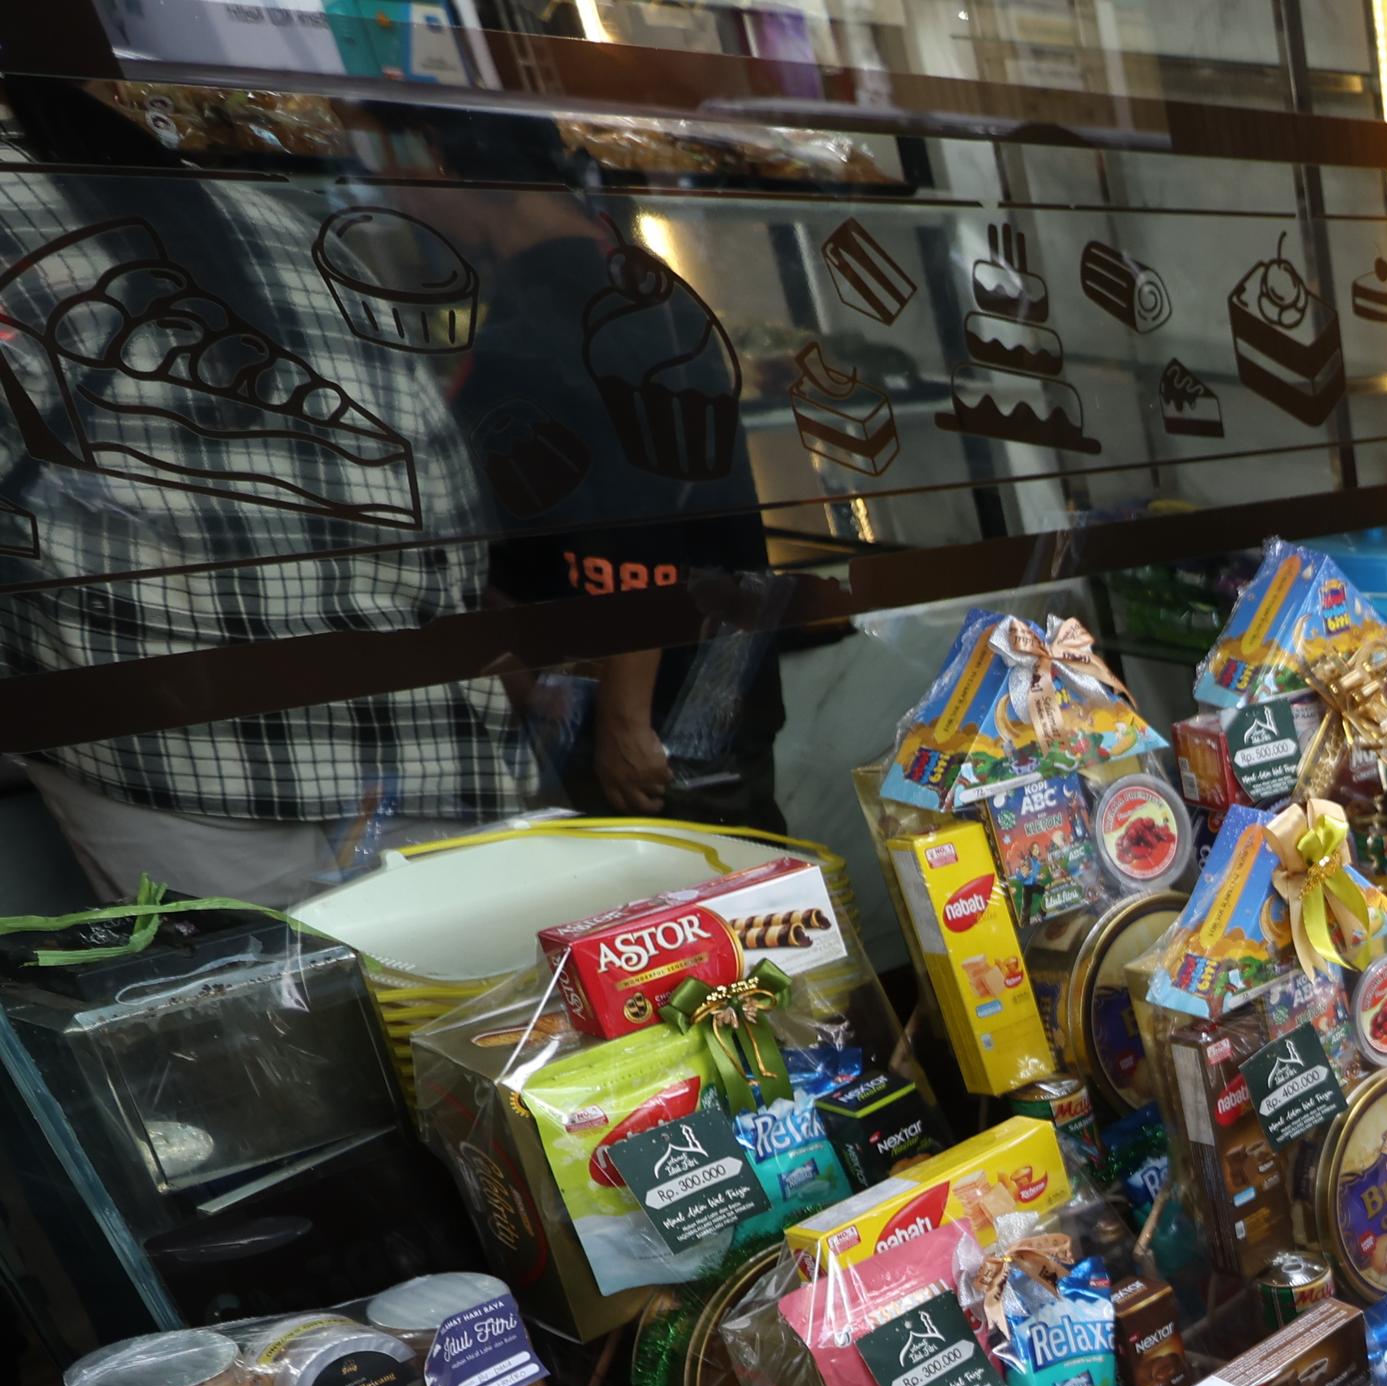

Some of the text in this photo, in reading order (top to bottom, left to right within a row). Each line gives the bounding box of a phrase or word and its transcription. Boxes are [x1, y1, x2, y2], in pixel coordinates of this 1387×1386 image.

[1256, 743, 1288, 759] 500.000
[1020, 788, 1058, 815] ABC
[1024, 782, 1048, 794] KOPI
[945, 893, 986, 921] nabati
[597, 914, 712, 973] ASTOR
[1282, 1070, 1320, 1098] 400.000
[657, 1164, 726, 1204] Rp. 300.000
[443, 1312, 520, 1363] Idul Fitri
[923, 1348, 962, 1380] 300.000
